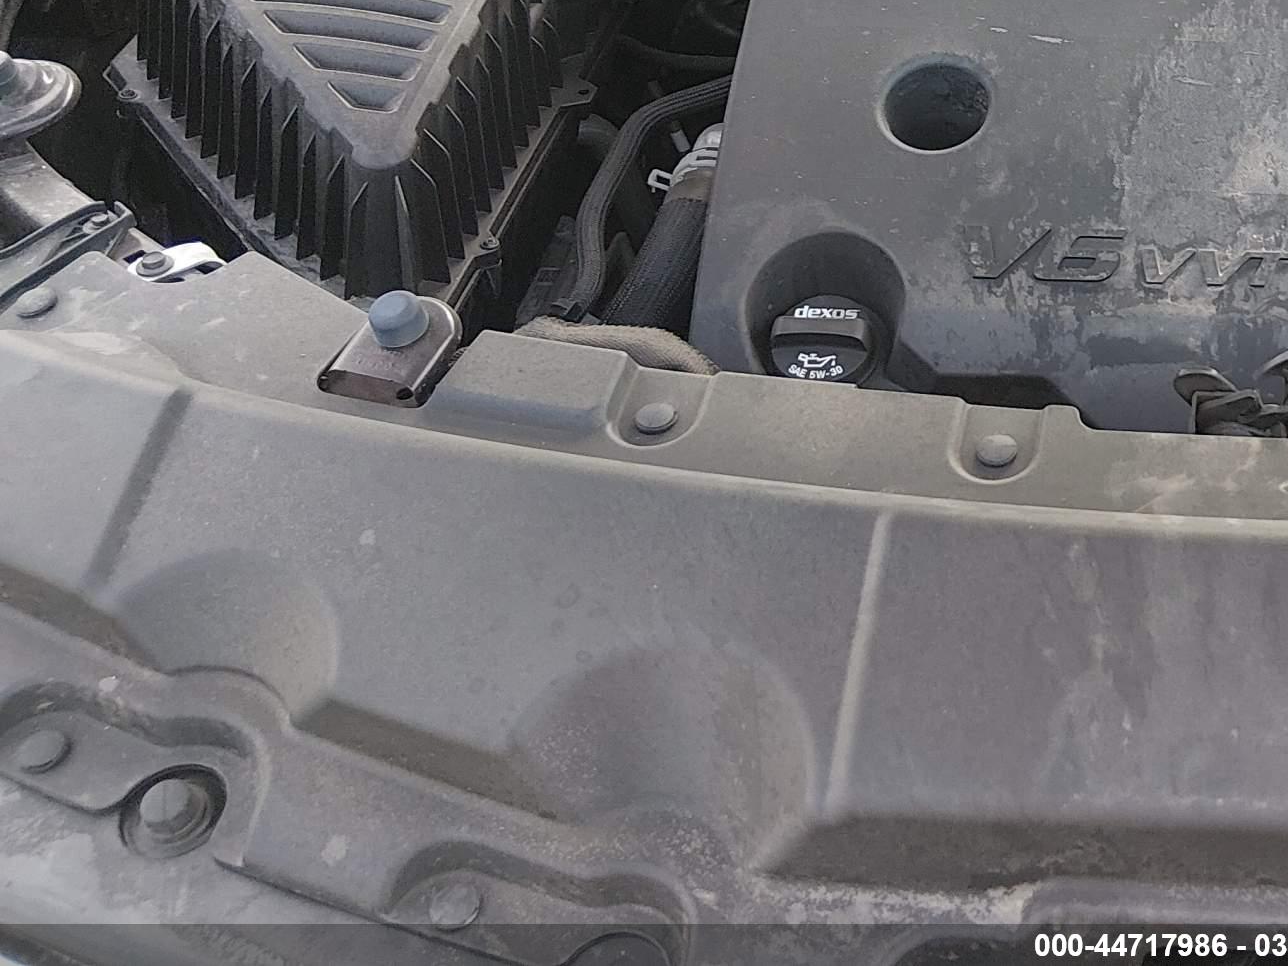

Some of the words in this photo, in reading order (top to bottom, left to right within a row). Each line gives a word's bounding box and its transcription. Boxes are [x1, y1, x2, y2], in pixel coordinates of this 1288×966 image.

[794, 305, 861, 319] dexos
[788, 364, 807, 379] SAE
[808, 365, 844, 379] 5W-30
